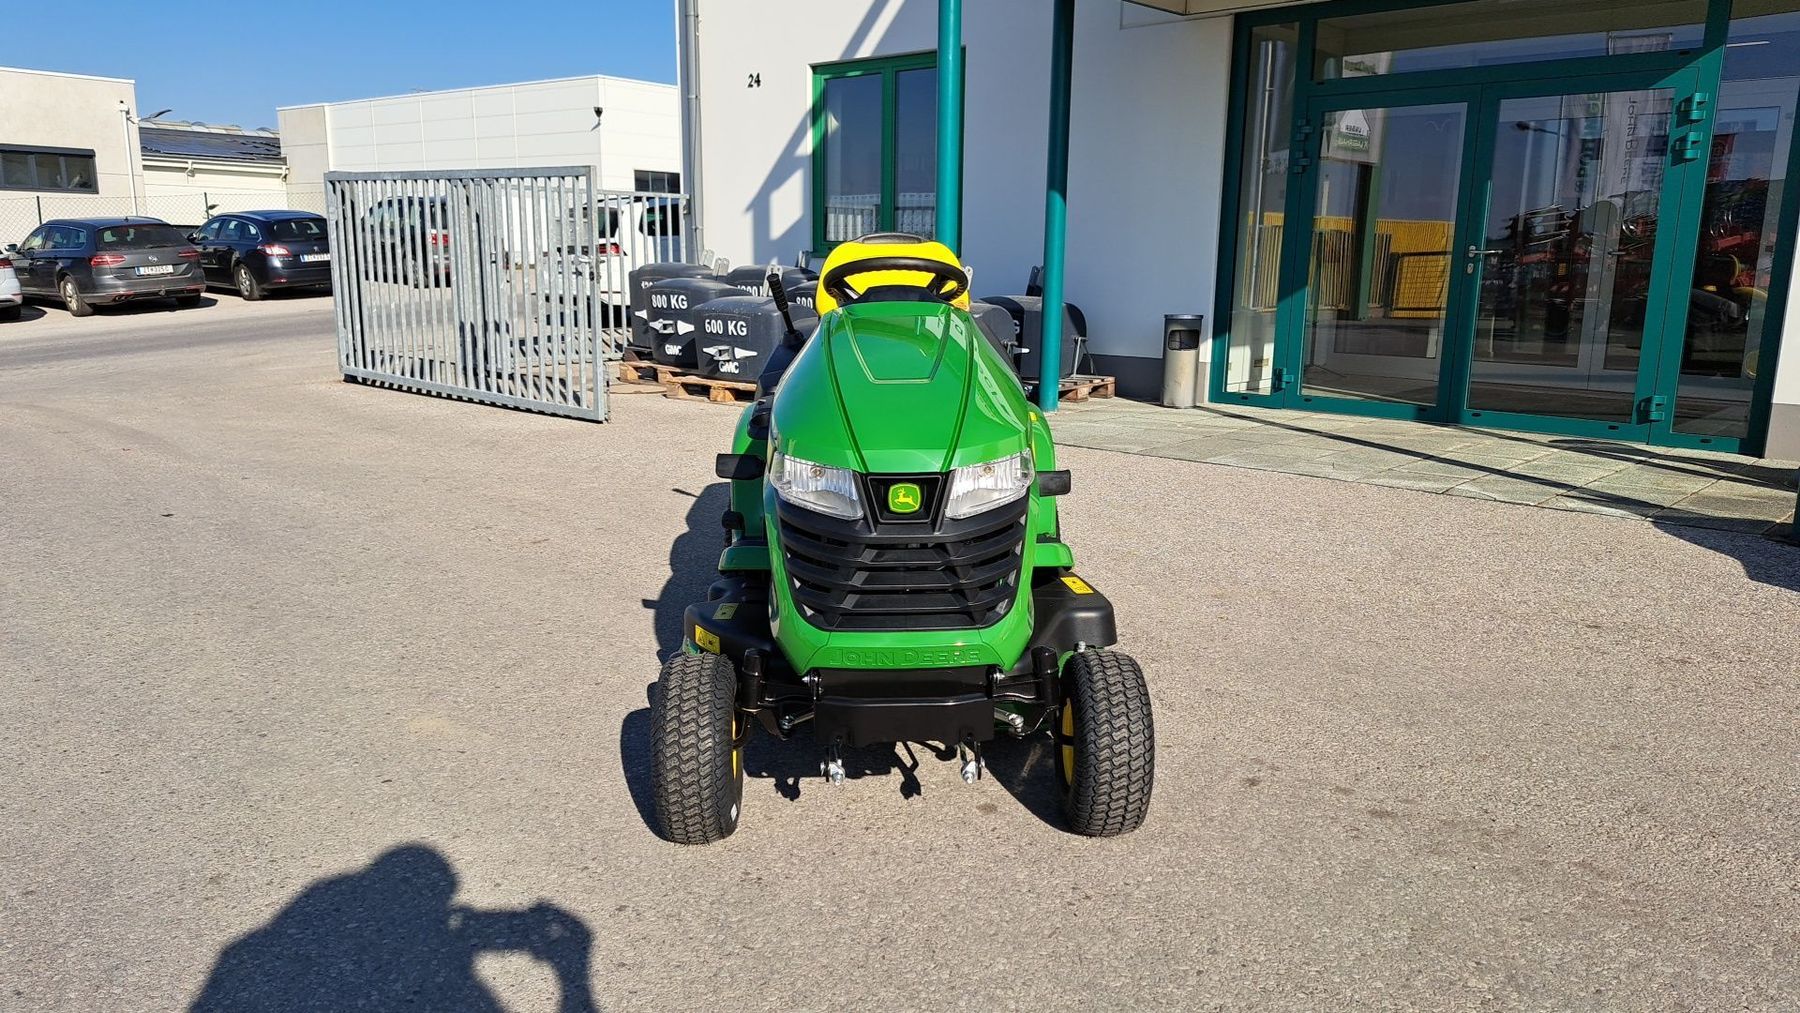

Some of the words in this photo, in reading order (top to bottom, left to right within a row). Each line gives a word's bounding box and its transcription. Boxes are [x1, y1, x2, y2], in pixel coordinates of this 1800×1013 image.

[747, 72, 761, 88] 24
[651, 294, 667, 309] 800
[670, 294, 688, 309] KG
[705, 319, 723, 334] 600
[727, 320, 747, 336] KG
[718, 360, 740, 374] GMC
[829, 648, 895, 666] JOHN
[900, 648, 981, 666] DEERE
